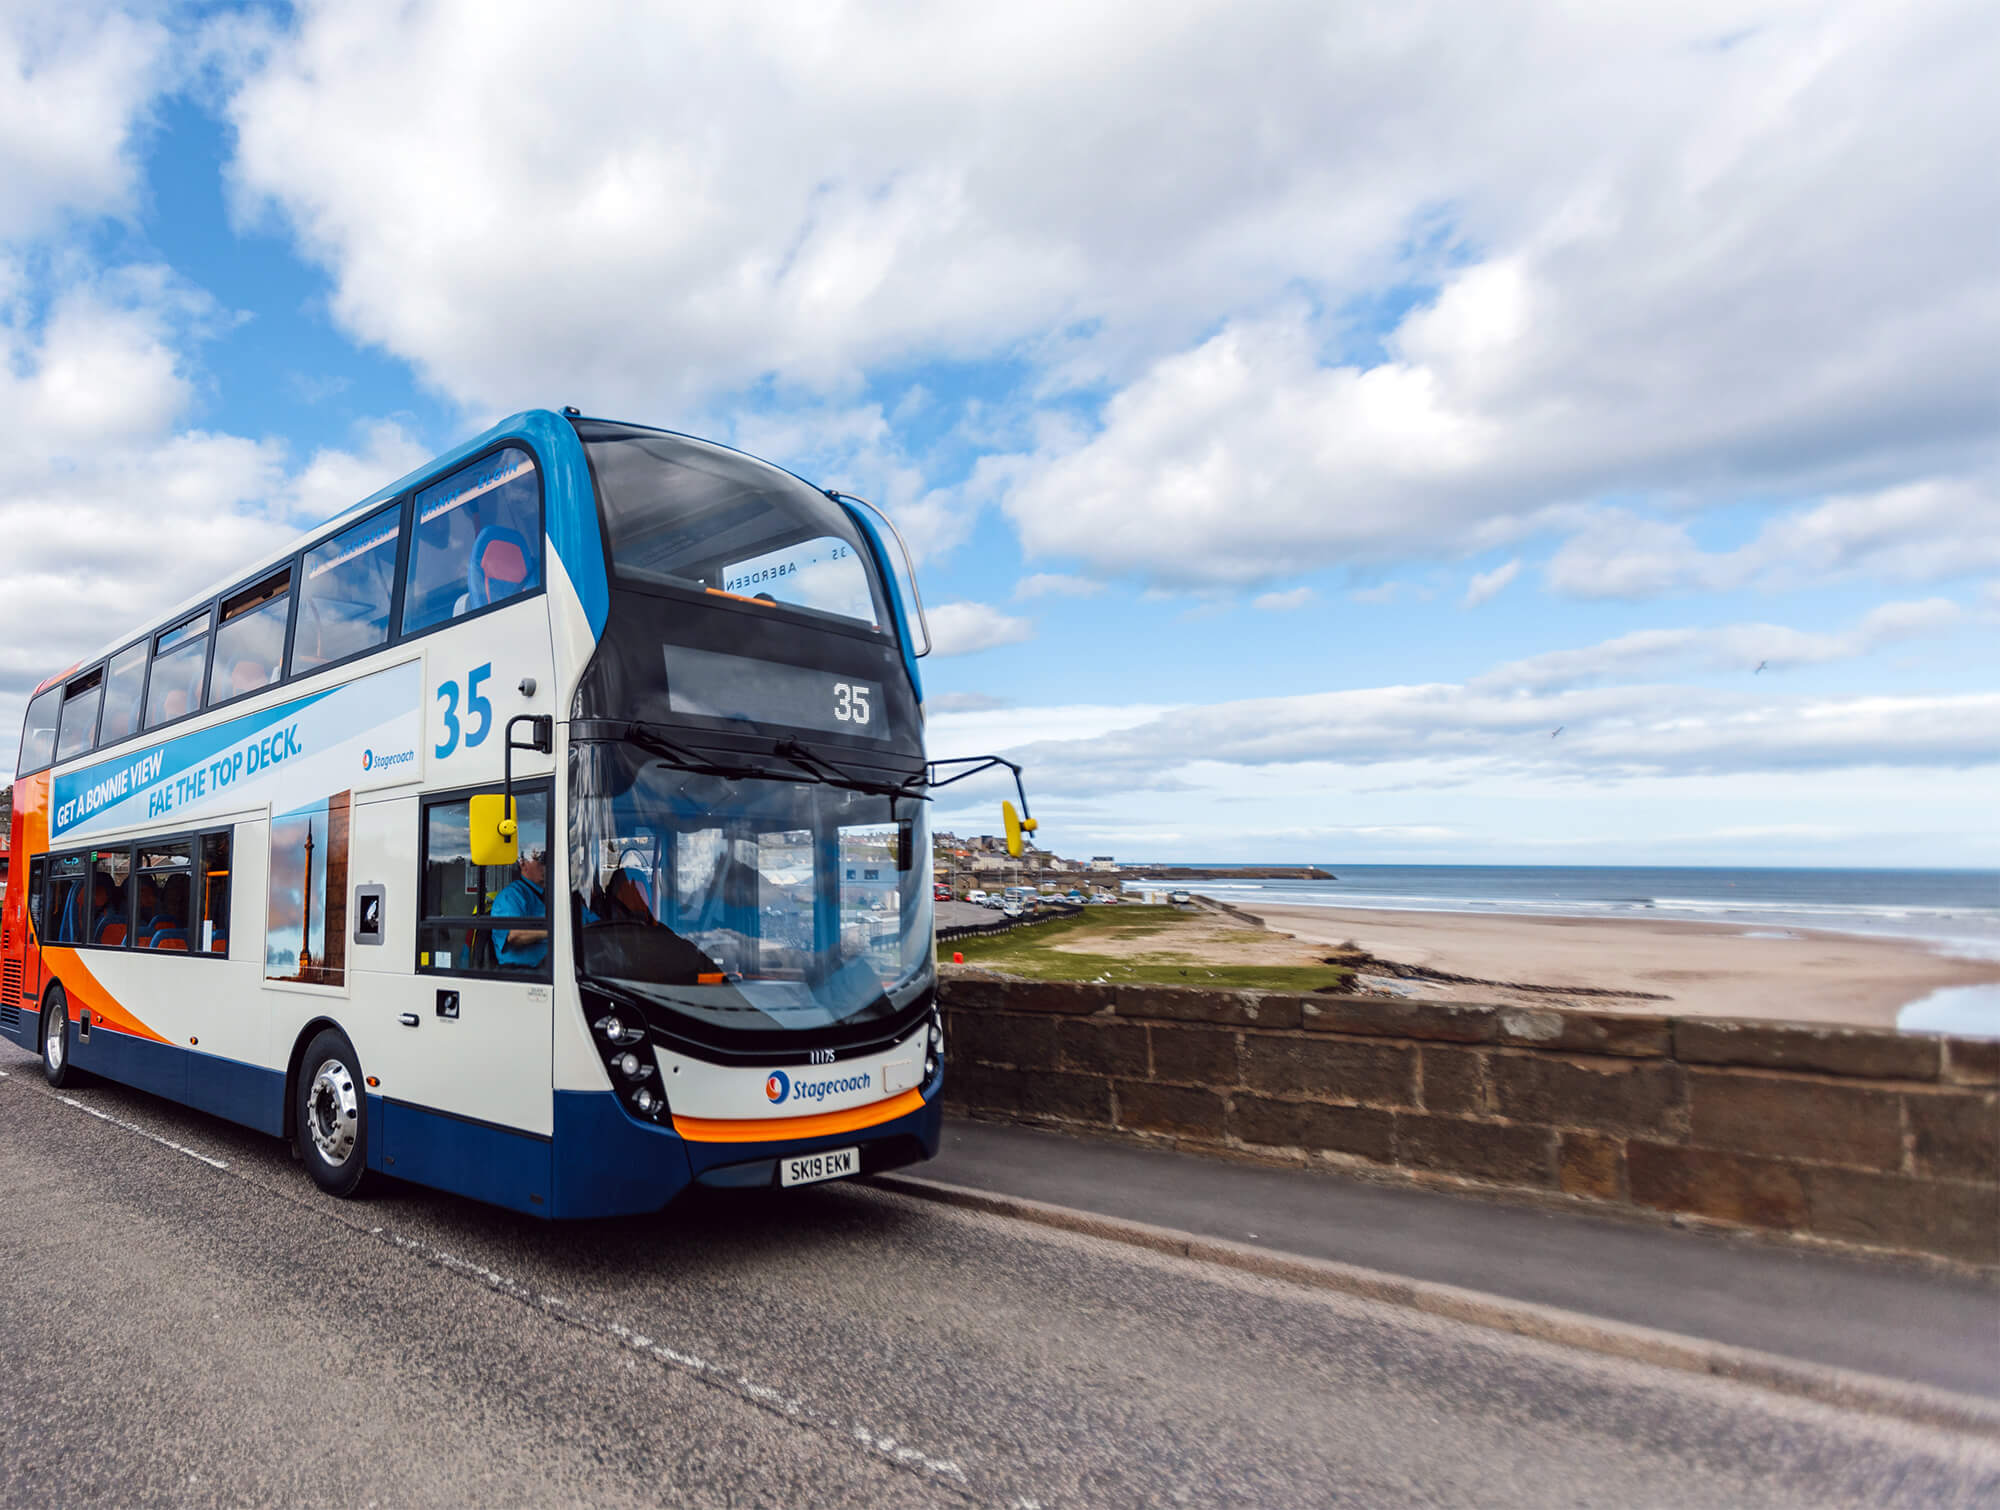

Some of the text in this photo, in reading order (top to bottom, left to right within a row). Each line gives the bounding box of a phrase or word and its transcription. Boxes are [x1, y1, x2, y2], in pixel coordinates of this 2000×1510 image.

[478, 459, 520, 490] ELGIN
[435, 662, 492, 759] 35
[834, 683, 869, 725] 35
[148, 723, 302, 819] FAE THE TOP DECK.
[373, 748, 415, 770] Stagecoach
[57, 749, 164, 828] GET A BONNIE VIEW
[810, 1048, 836, 1064] 11175
[793, 1072, 870, 1102] Stagecoach
[791, 1152, 851, 1180] SK19 EKW
